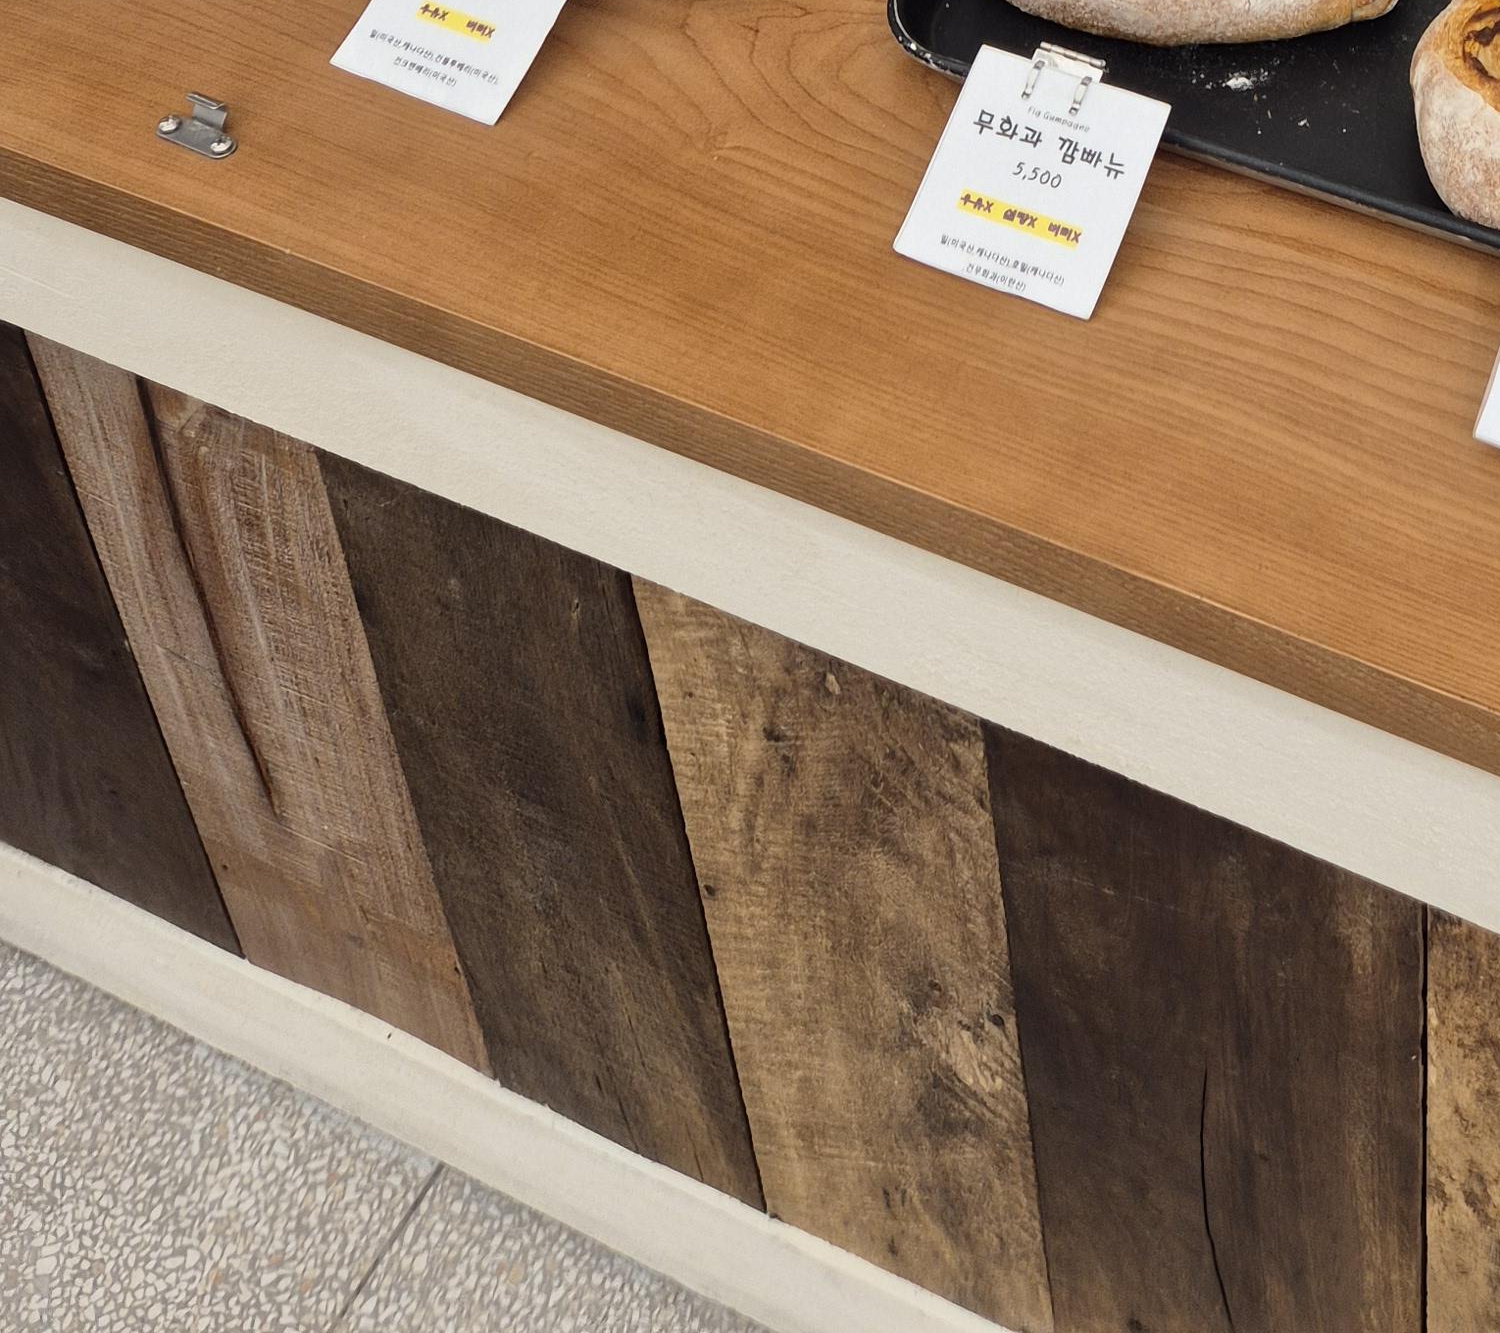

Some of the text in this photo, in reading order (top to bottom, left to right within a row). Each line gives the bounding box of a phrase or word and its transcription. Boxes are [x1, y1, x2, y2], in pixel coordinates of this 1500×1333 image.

[974, 110, 1124, 179] 무화과 깜빠뉴
[1013, 162, 1061, 188] 5,500
